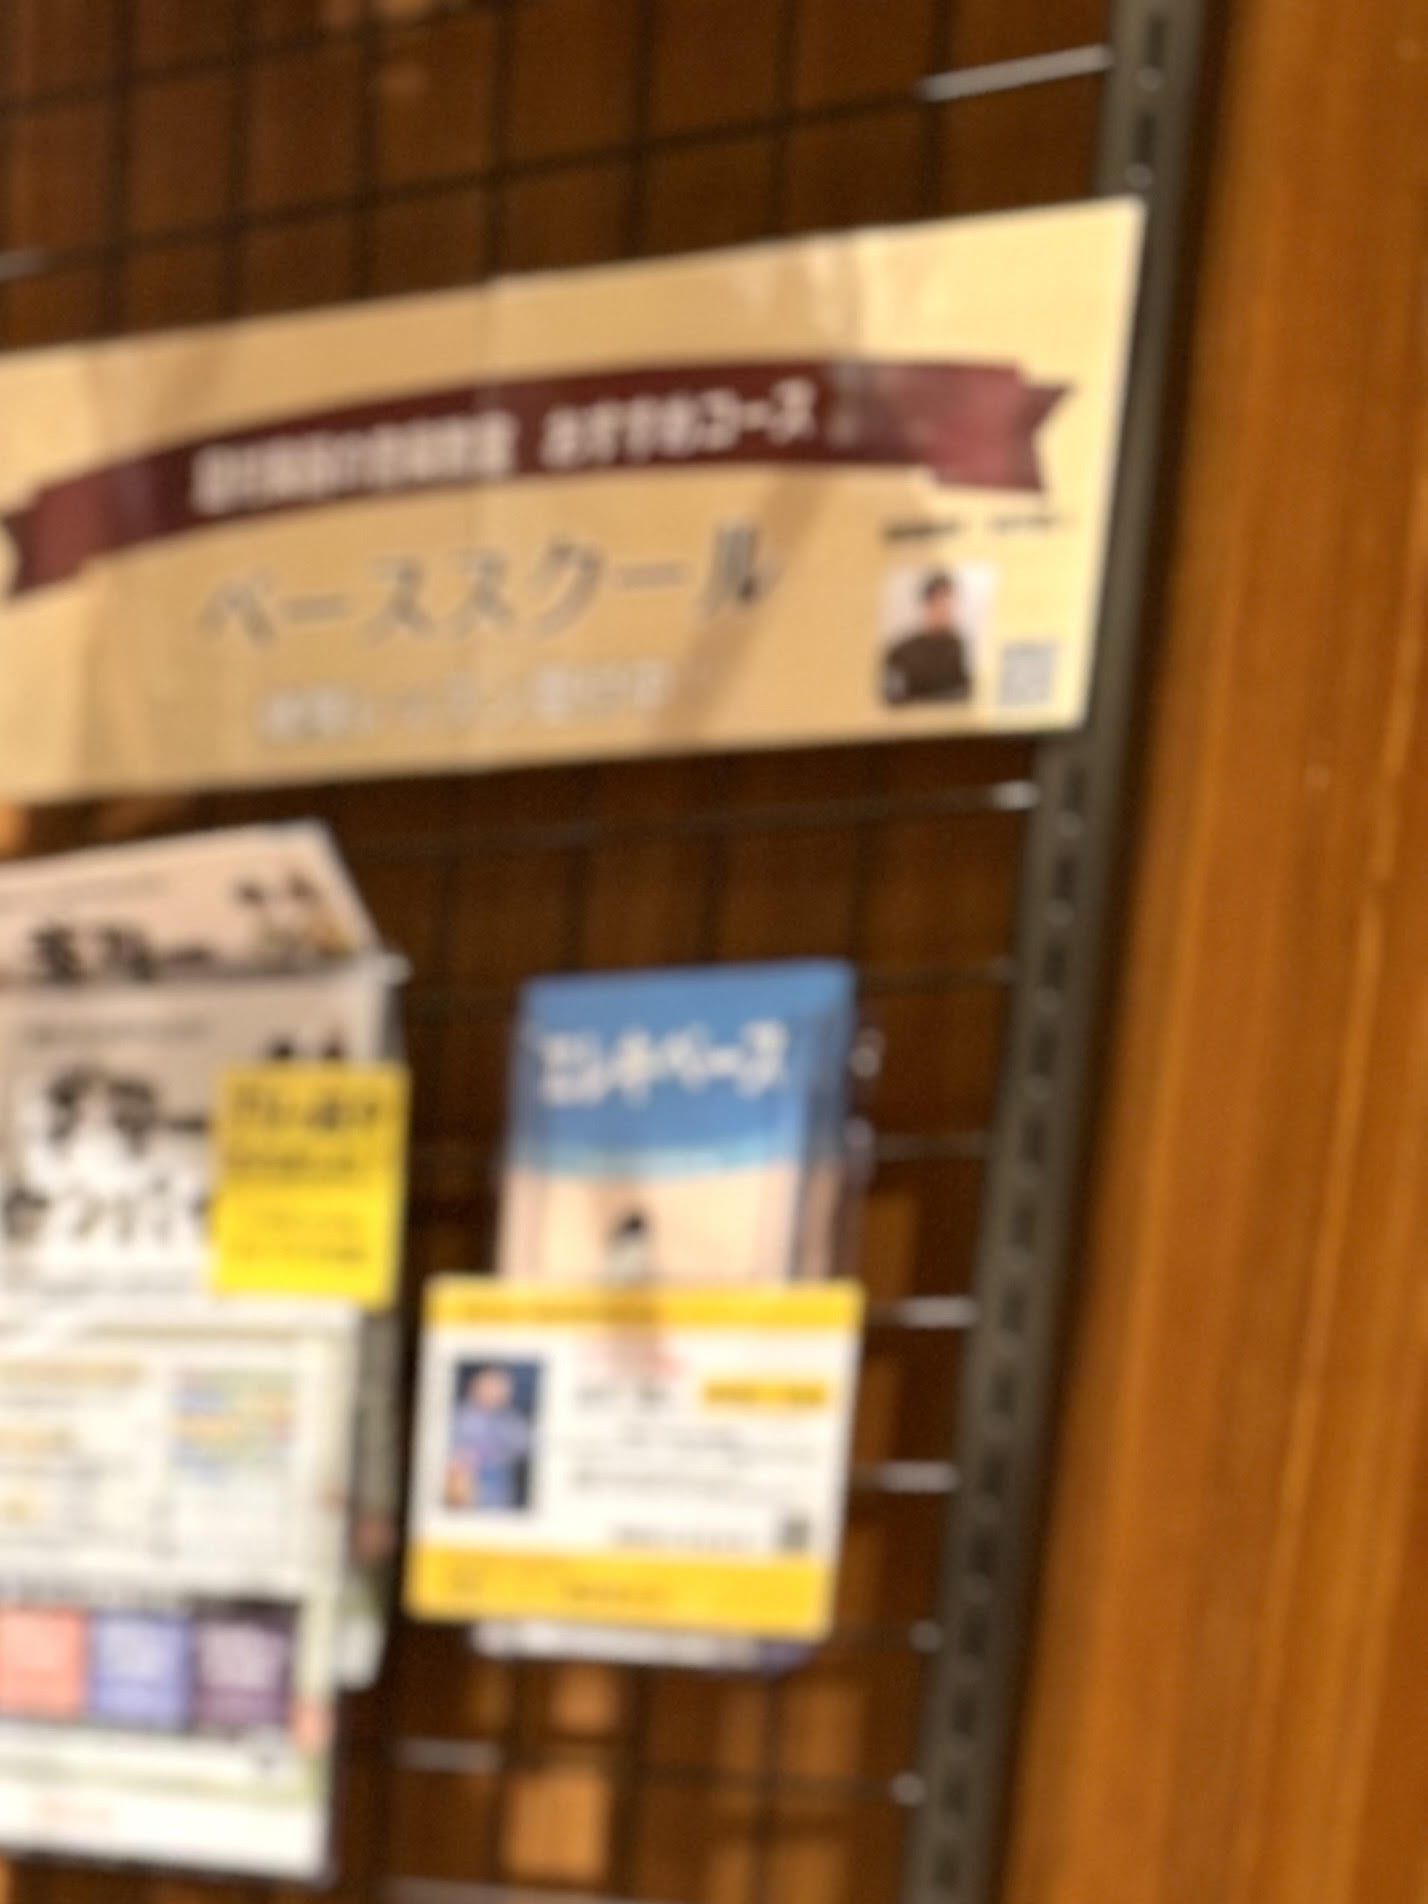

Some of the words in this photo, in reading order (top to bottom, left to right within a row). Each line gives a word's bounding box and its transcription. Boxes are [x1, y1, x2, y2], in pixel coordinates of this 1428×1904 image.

[197, 518, 762, 652] ベーススクール
